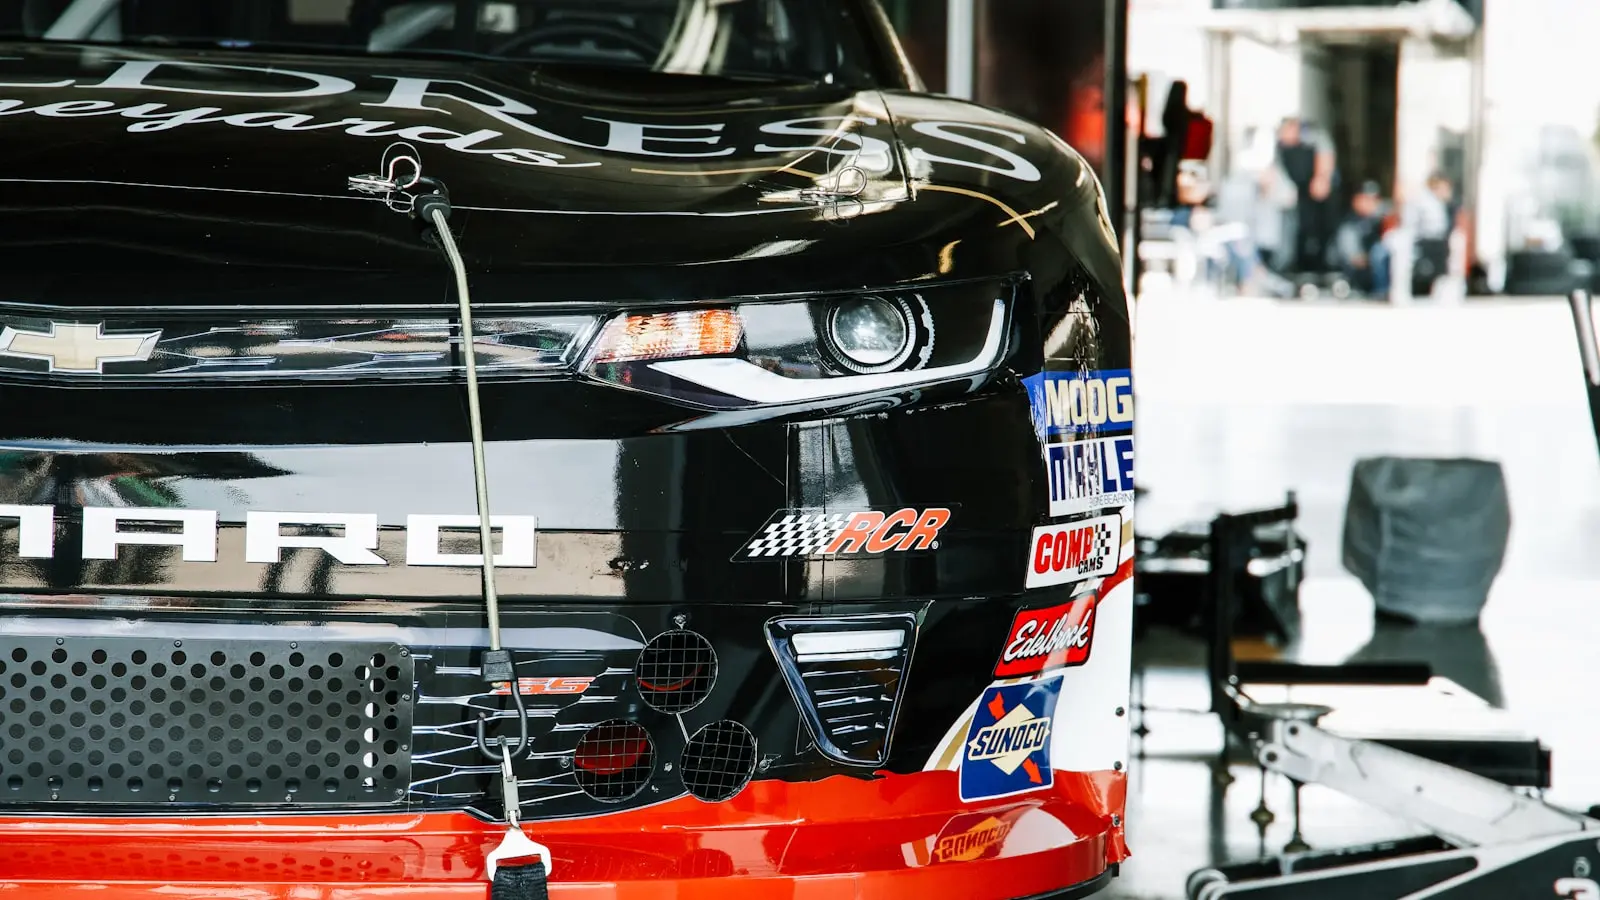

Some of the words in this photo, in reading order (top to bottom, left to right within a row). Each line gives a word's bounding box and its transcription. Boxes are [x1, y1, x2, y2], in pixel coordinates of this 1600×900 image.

[1045, 377, 1134, 427] MOOG
[1034, 526, 1094, 574] COMP
[1077, 556, 1104, 575] CAMS
[1003, 608, 1089, 662] Edelbrock
[971, 721, 1047, 757] SUNOCO
